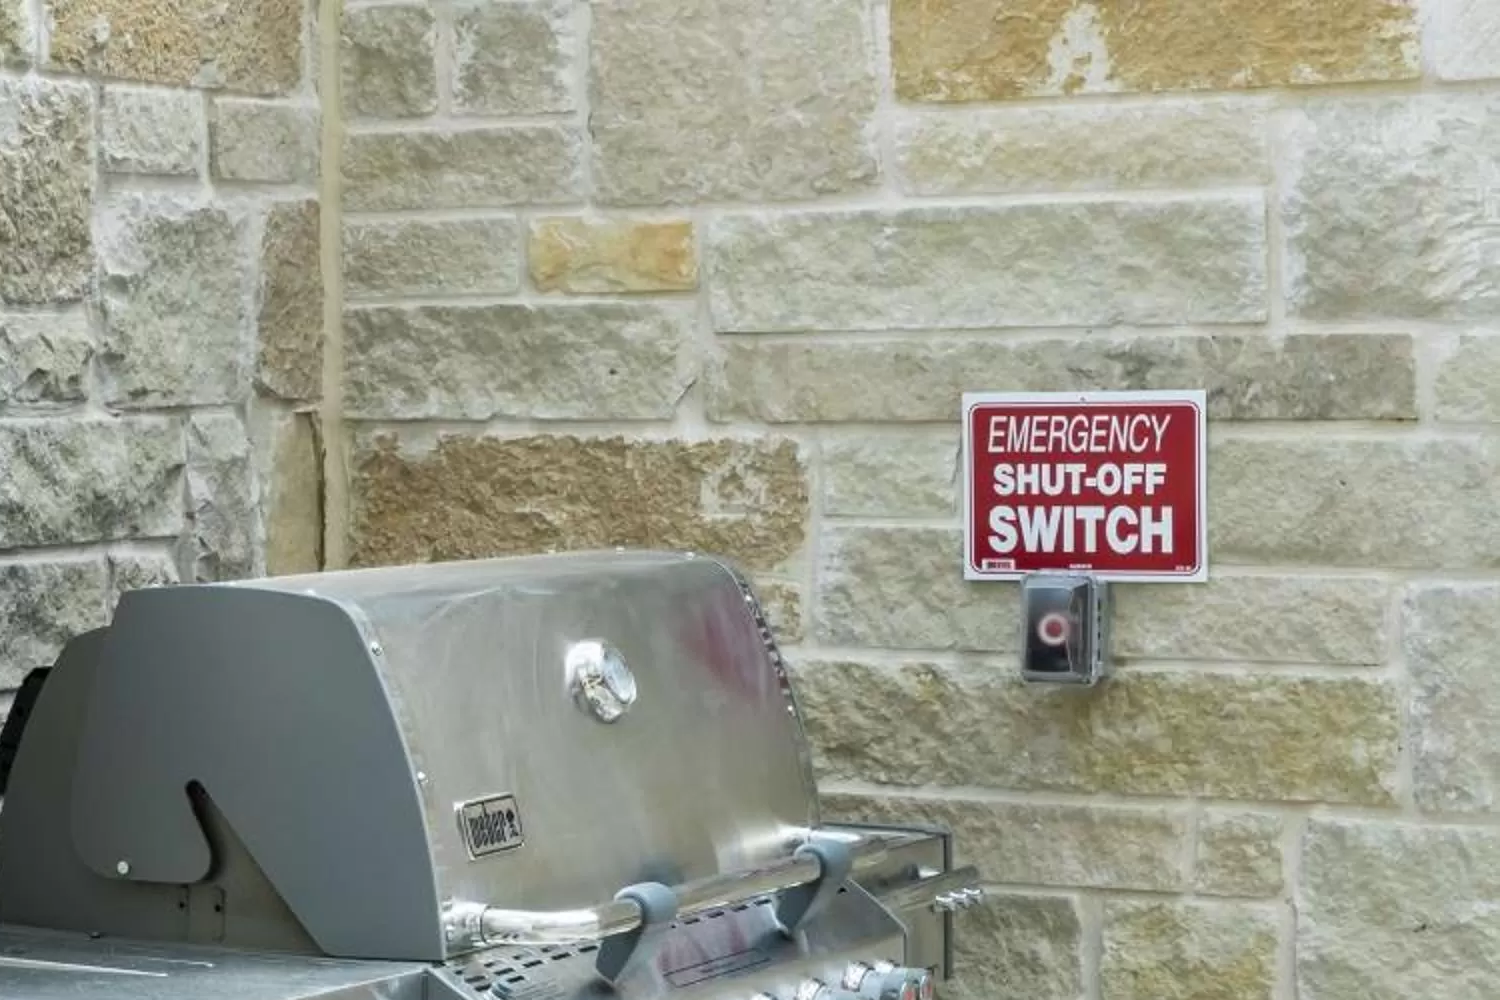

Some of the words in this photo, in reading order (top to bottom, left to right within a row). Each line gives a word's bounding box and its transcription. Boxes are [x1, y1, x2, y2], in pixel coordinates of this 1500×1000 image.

[987, 413, 1172, 453] EMERGENCY
[993, 462, 1167, 496] SHUT-OFF
[987, 505, 1173, 555] SWITCH
[467, 801, 507, 849] weber
